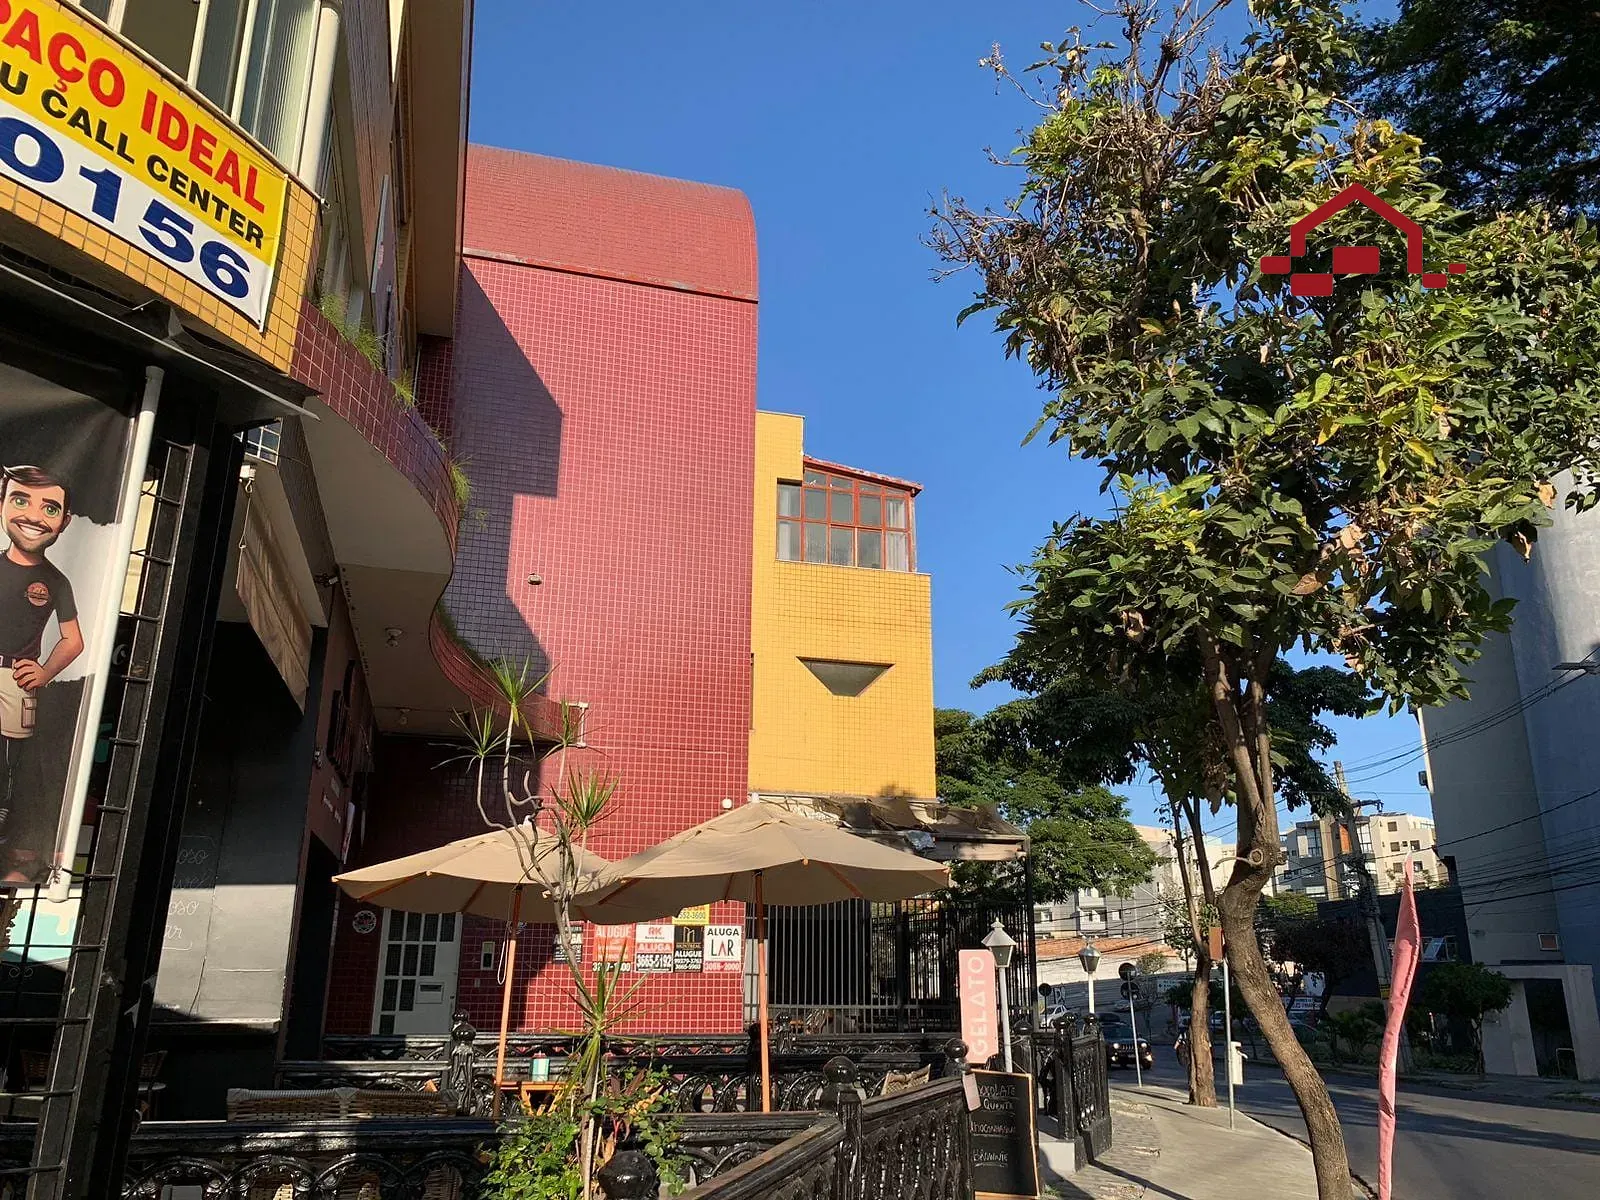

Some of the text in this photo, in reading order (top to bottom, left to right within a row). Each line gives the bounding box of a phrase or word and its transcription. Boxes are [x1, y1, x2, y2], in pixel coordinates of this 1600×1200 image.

[41, 89, 135, 165] CALL
[147, 154, 265, 250] CENTER
[140, 88, 266, 214] IDEAL
[0, 116, 250, 299] 0156
[637, 943, 671, 952] ALUGA
[674, 950, 703, 958] ALUGUE
[707, 928, 740, 936] ALUGA
[711, 939, 734, 957] LAR
[967, 955, 987, 1057] GELATO
